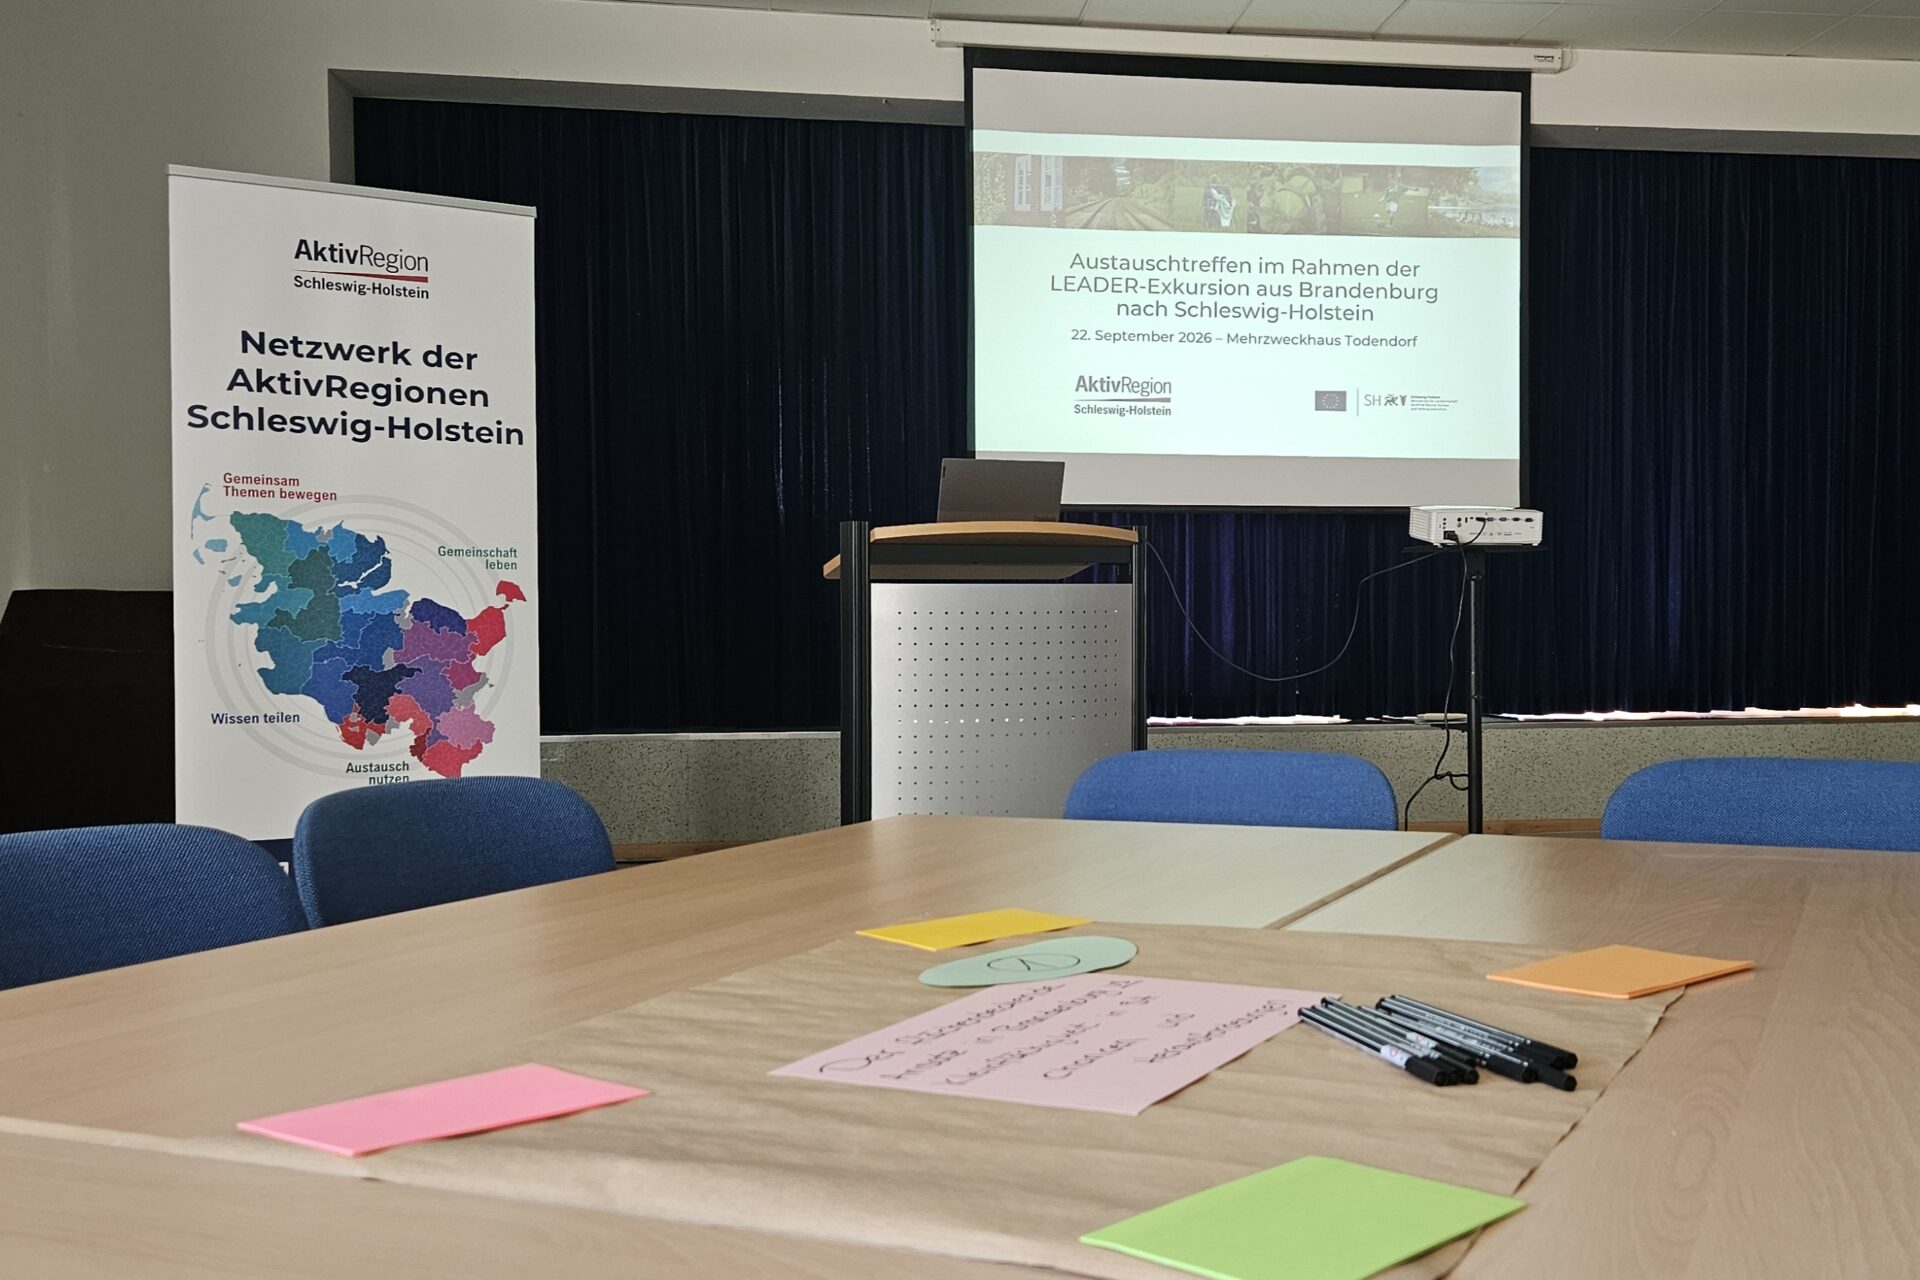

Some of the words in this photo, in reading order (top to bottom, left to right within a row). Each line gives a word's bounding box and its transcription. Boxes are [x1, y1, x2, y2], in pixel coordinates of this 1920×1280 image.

[294, 239, 429, 273] AktivRegion
[1070, 253, 1251, 275] Austauschtreffen
[1259, 258, 1284, 274] im
[1293, 258, 1379, 277] Rahmen
[1386, 260, 1420, 277] der
[294, 275, 429, 299] Schleswig-Holstein
[1051, 275, 1250, 297] LEADER-Exkursion
[1256, 283, 1292, 298] aus
[1300, 281, 1438, 303] Brandenburg
[1117, 300, 1168, 317] nach
[1174, 301, 1374, 323] Schleswig-Holstein
[1071, 329, 1091, 341] 22.
[1095, 329, 1174, 344] September
[1178, 331, 1212, 344] 2026
[1227, 333, 1341, 346] Mehrzweckhaus
[1345, 334, 1418, 348] Todendorf
[240, 330, 412, 366] Netzwerk
[422, 345, 478, 370] der
[227, 368, 489, 407] AktivRegionen
[1075, 375, 1172, 395] AktivRegion
[1364, 394, 1381, 406] SH
[1074, 404, 1171, 417] Schleswig-Holstein
[187, 404, 524, 445] Schleswig-Holstein
[223, 472, 300, 487] Gemeinsam
[223, 485, 275, 499] Themen
[280, 488, 337, 503] bewegen
[438, 546, 517, 559] Gemeinschaft
[485, 559, 517, 570] leben
[211, 713, 259, 725] Wissen
[263, 712, 300, 724] teilen
[346, 761, 410, 774] Austausch
[369, 774, 410, 785] nutzen
